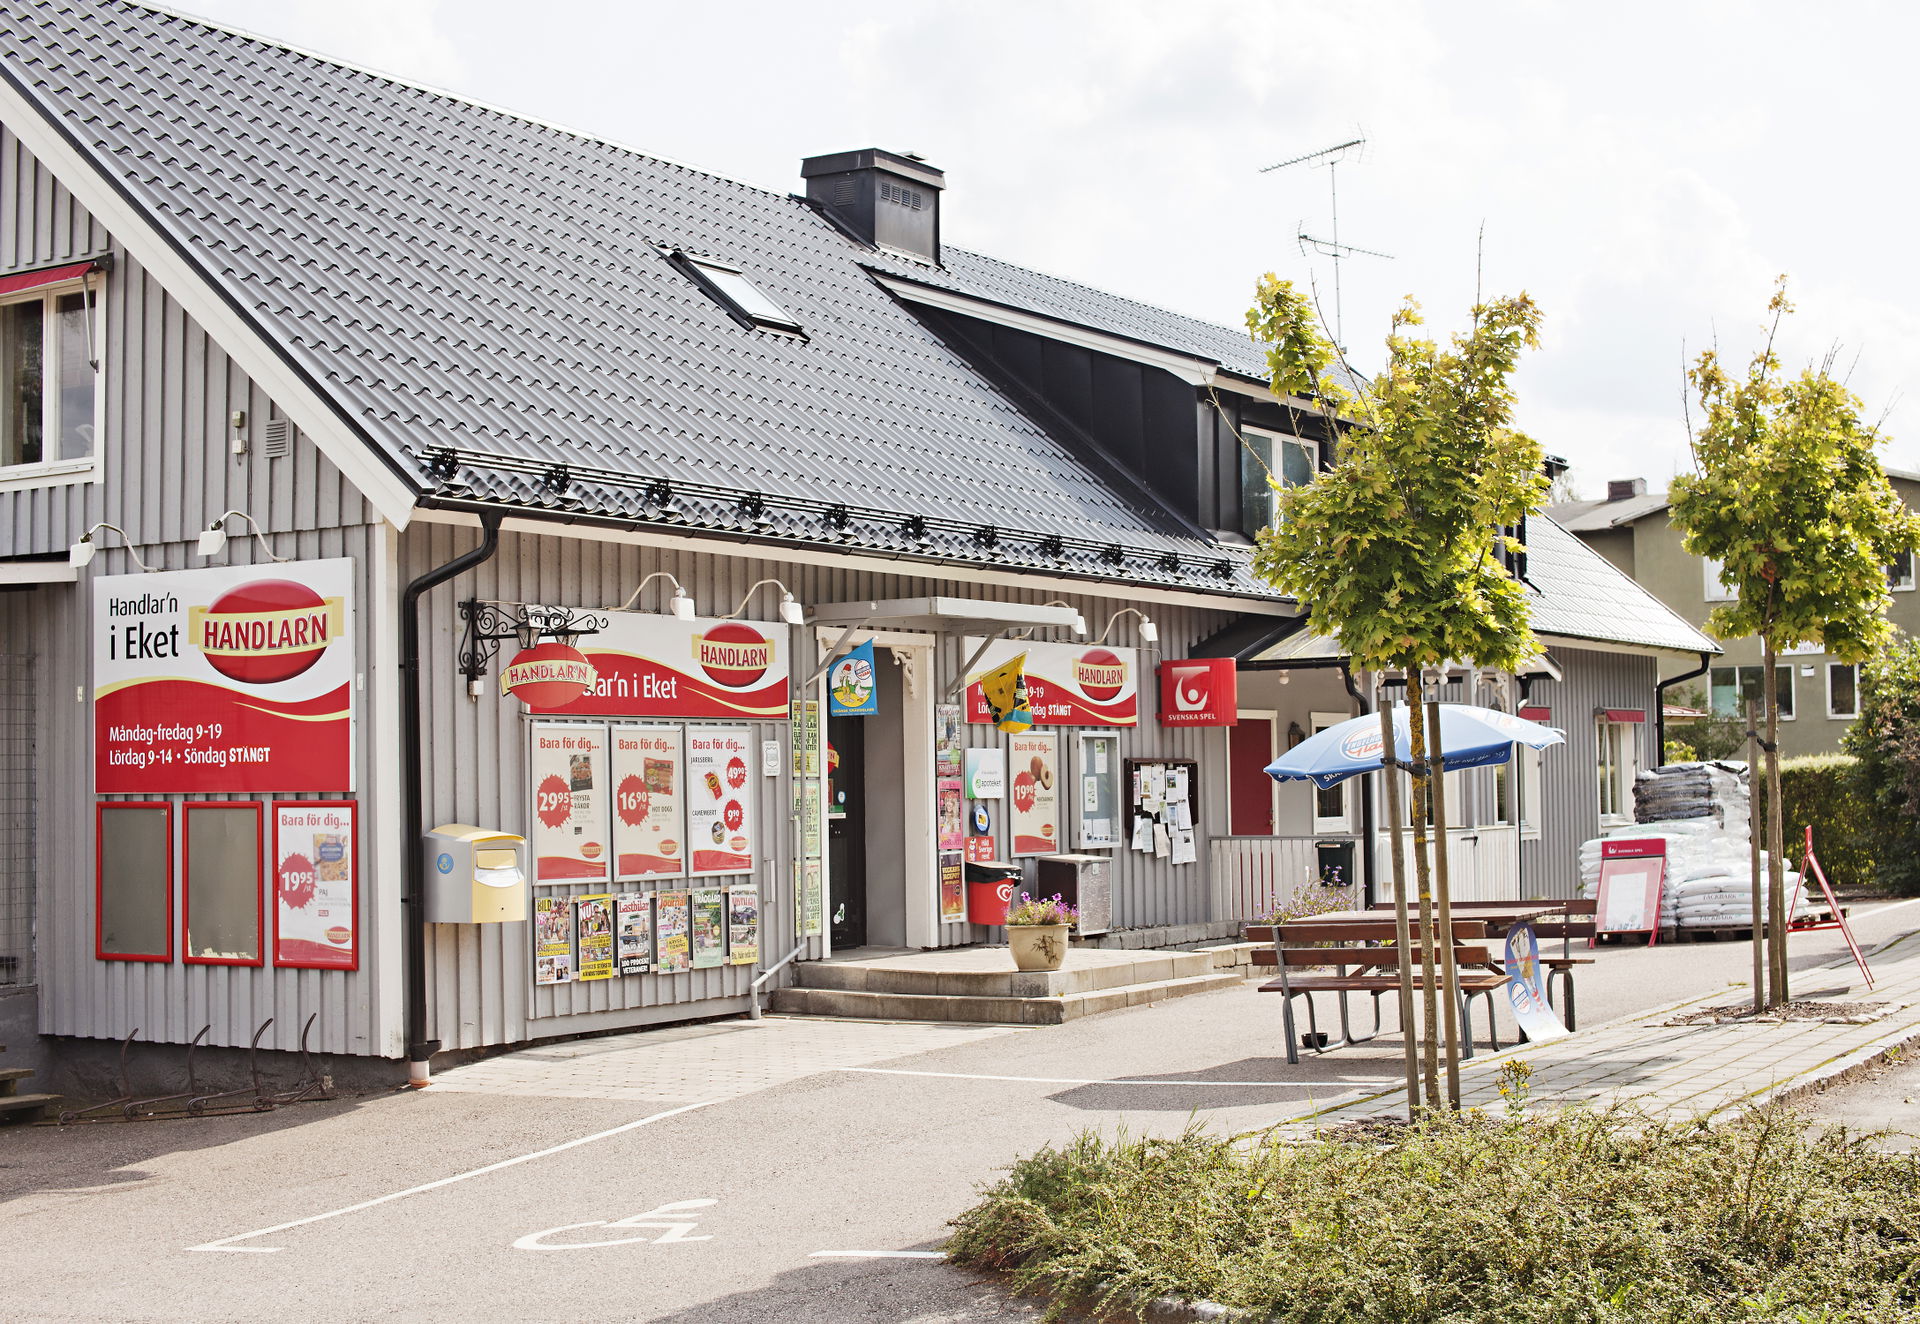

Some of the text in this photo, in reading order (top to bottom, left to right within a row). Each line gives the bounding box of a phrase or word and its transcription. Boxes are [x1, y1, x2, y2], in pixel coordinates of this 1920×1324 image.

[109, 592, 178, 617] Handlar'n
[110, 621, 179, 660] i Eket
[203, 612, 328, 651] HANDLAR'N
[509, 664, 588, 684] HANDLAR'N
[633, 674, 638, 697] i
[643, 673, 677, 699] Eket
[1029, 686, 1045, 698] 9-19
[109, 722, 223, 745] Måndag-fredag 9-19
[540, 736, 600, 752] Bara för dig...
[618, 738, 675, 752] Bara för dig...
[692, 738, 745, 752] Bara för dig...
[1014, 742, 1028, 751] Bara
[1028, 741, 1037, 751] för
[109, 746, 271, 769] Lördag 9-14 Söndag STÄNGT
[281, 813, 350, 829] Bara för dig...
